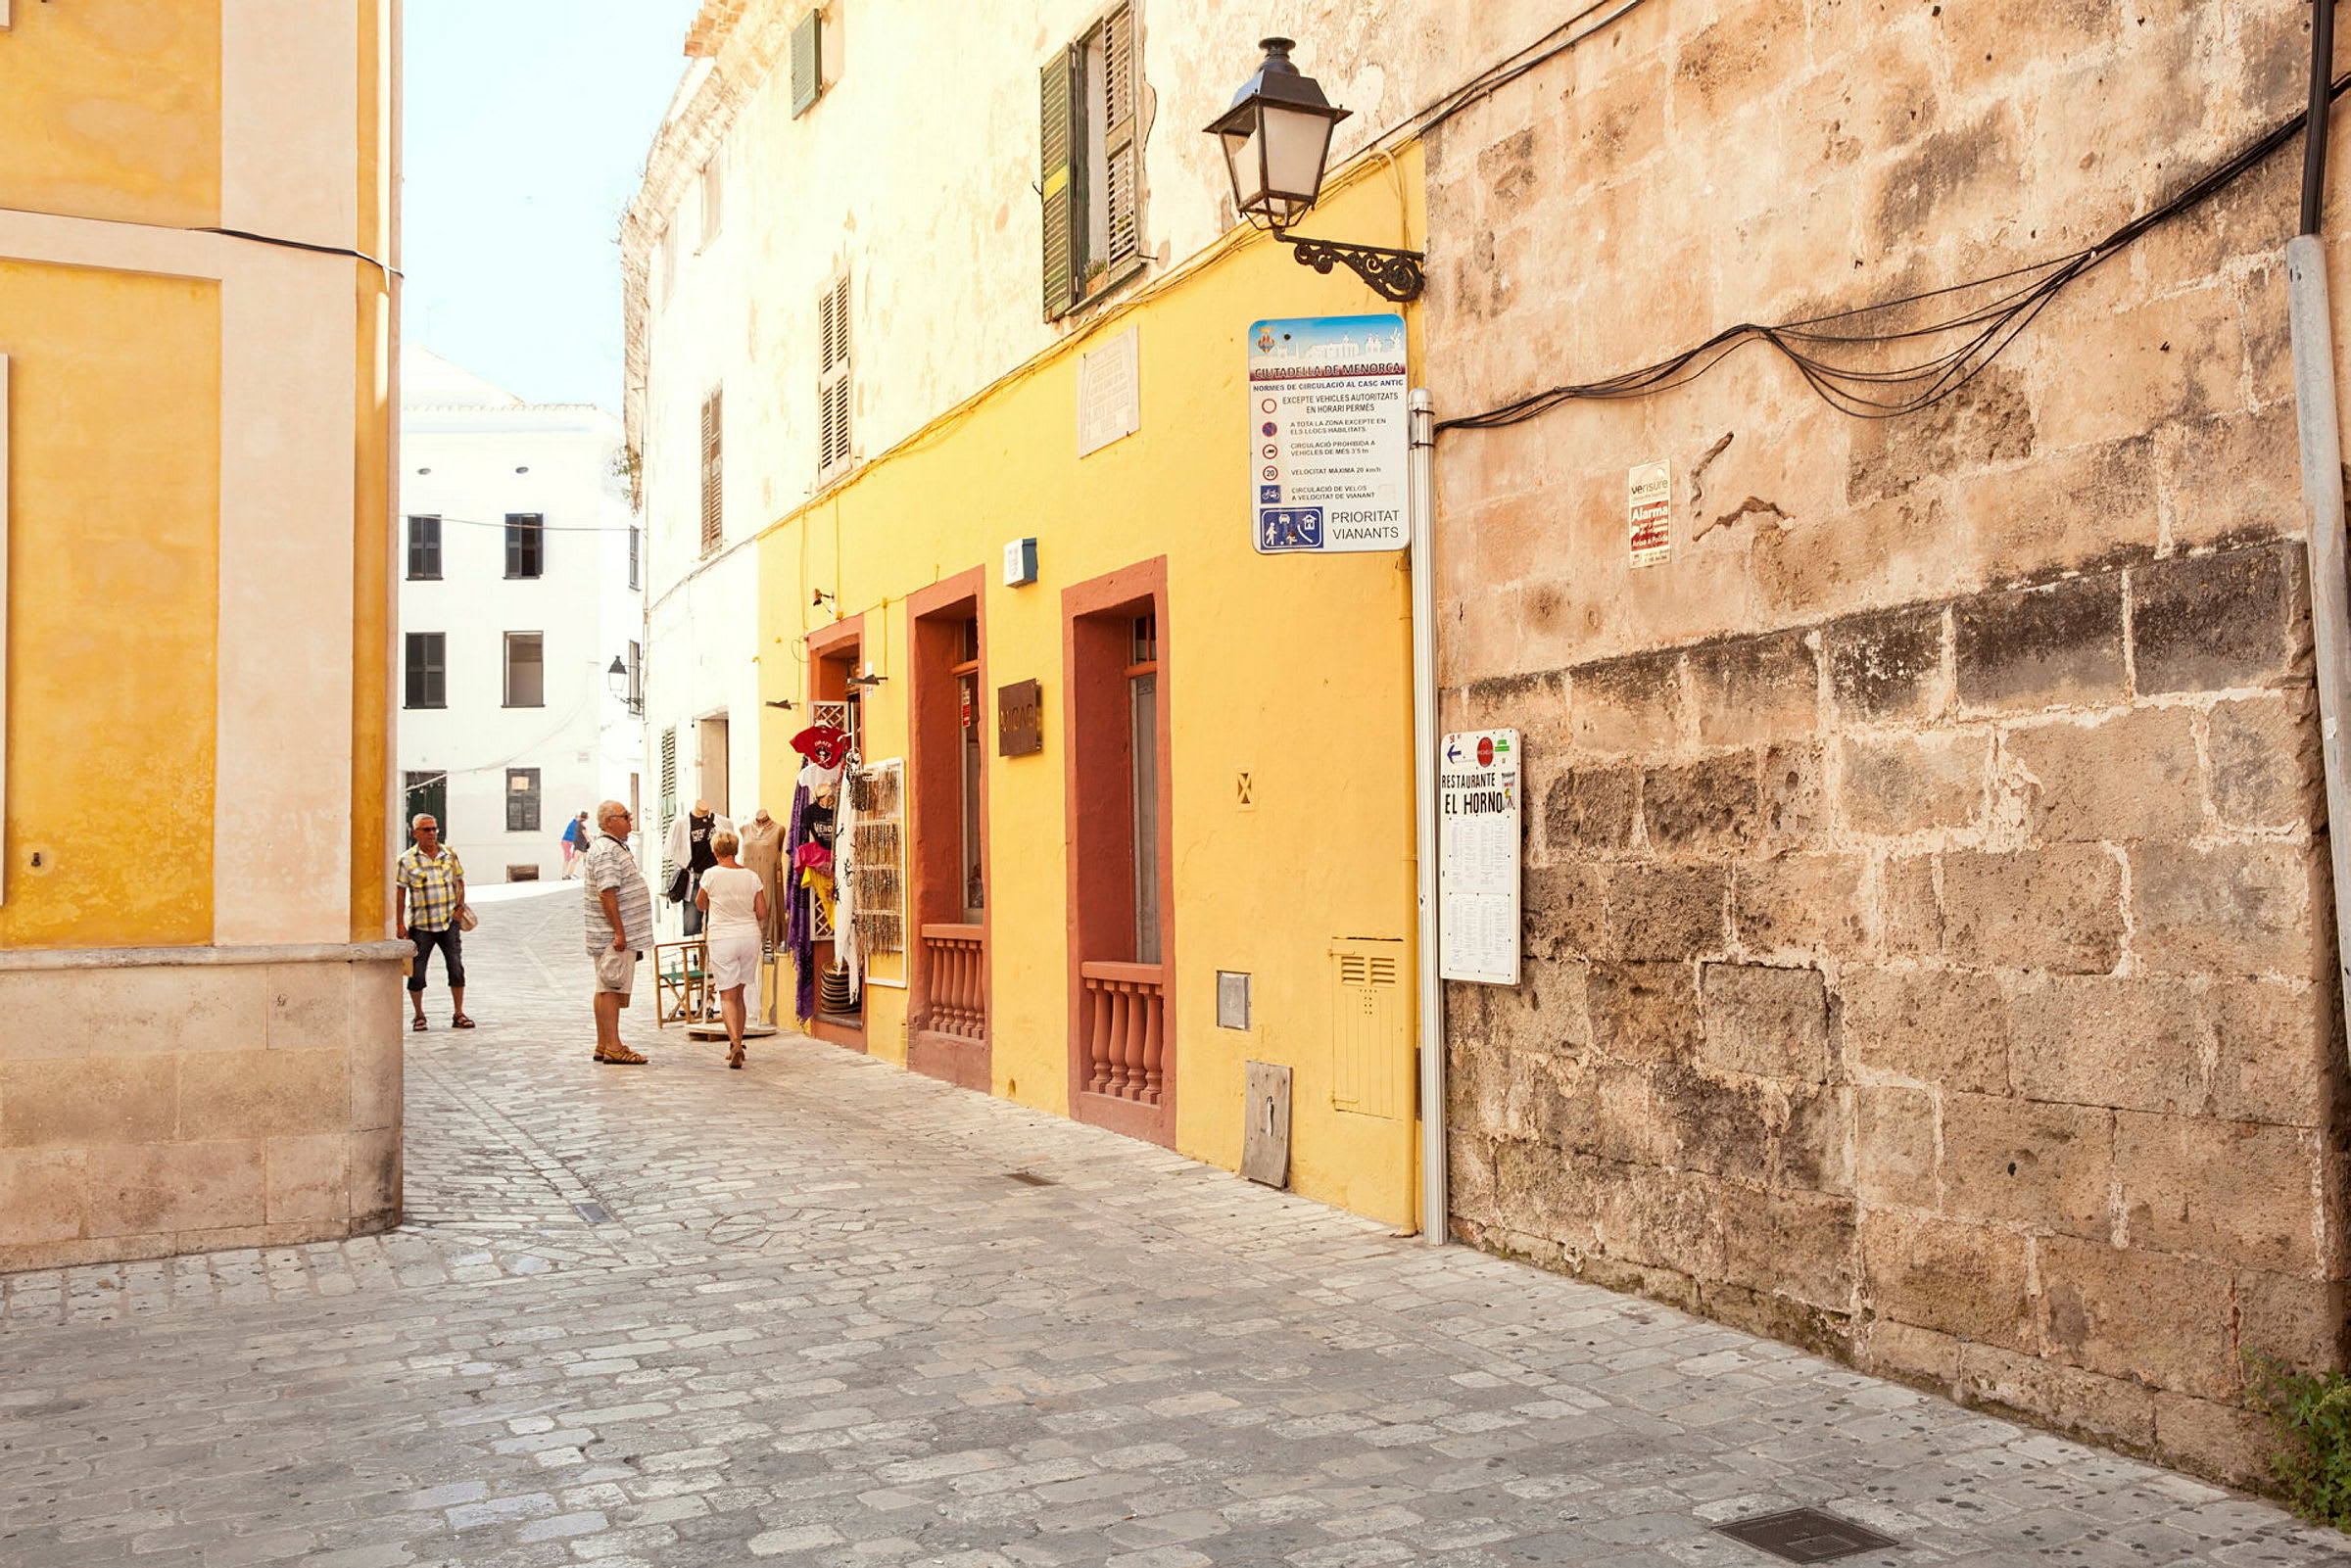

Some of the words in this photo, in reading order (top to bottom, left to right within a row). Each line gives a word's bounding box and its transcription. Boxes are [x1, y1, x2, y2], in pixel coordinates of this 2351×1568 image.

[1255, 365, 1321, 379] CIUTADELLA
[1324, 364, 1339, 375] DE
[1342, 362, 1401, 374] MENORCA
[1282, 396, 1315, 404] EXCEPTE
[1315, 394, 1350, 404] VEHICLES
[1351, 392, 1399, 402] AUTORITZATS
[1318, 404, 1345, 413] HORARI
[1631, 479, 1668, 495] verisure
[1331, 509, 1400, 523] PRIORITAT
[1631, 505, 1669, 523] Alarma
[1332, 526, 1399, 540] VIANANTS
[1441, 772, 1496, 789] RESTAURANTE
[1445, 793, 1458, 815] EL
[1463, 790, 1503, 815] HORNO
